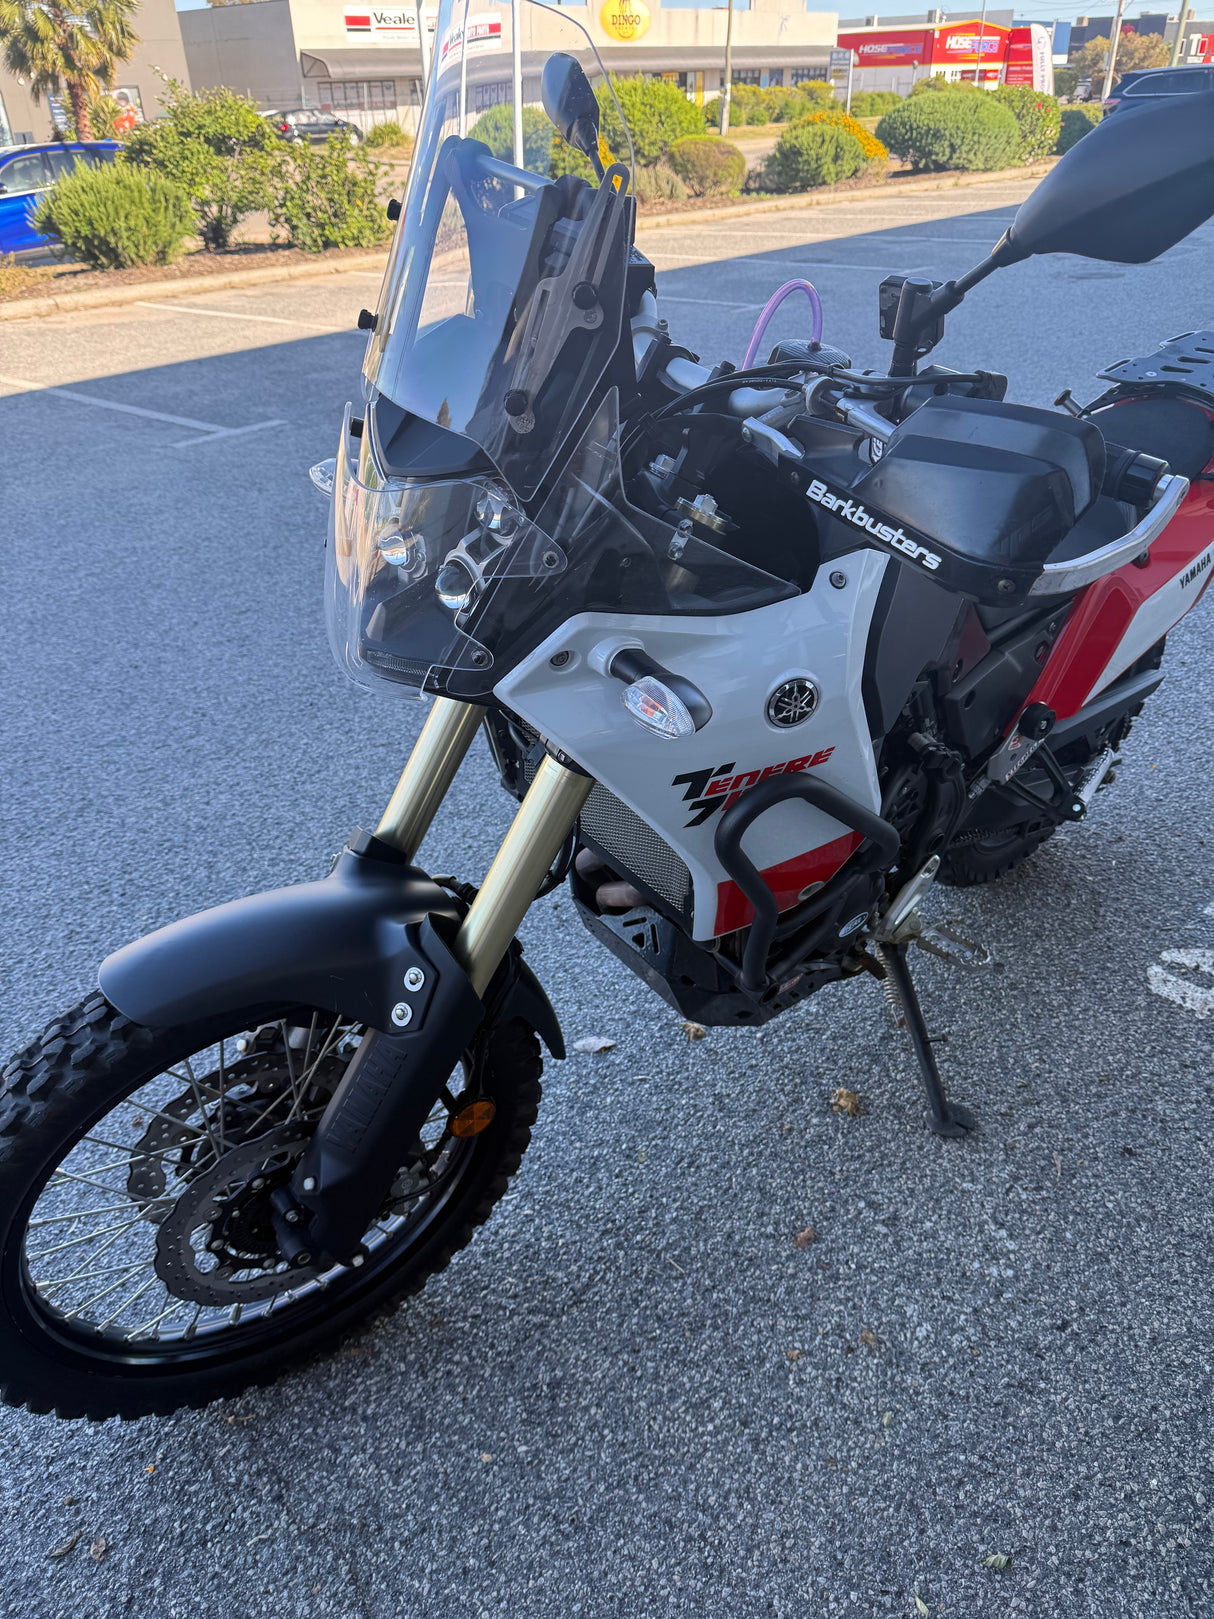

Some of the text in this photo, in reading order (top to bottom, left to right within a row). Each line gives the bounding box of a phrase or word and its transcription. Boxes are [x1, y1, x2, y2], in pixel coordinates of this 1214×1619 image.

[373, 12, 415, 25] Veale
[611, 14, 641, 26] DINGO
[805, 479, 943, 571] Barkbusters
[1179, 552, 1212, 590] YAMAHA
